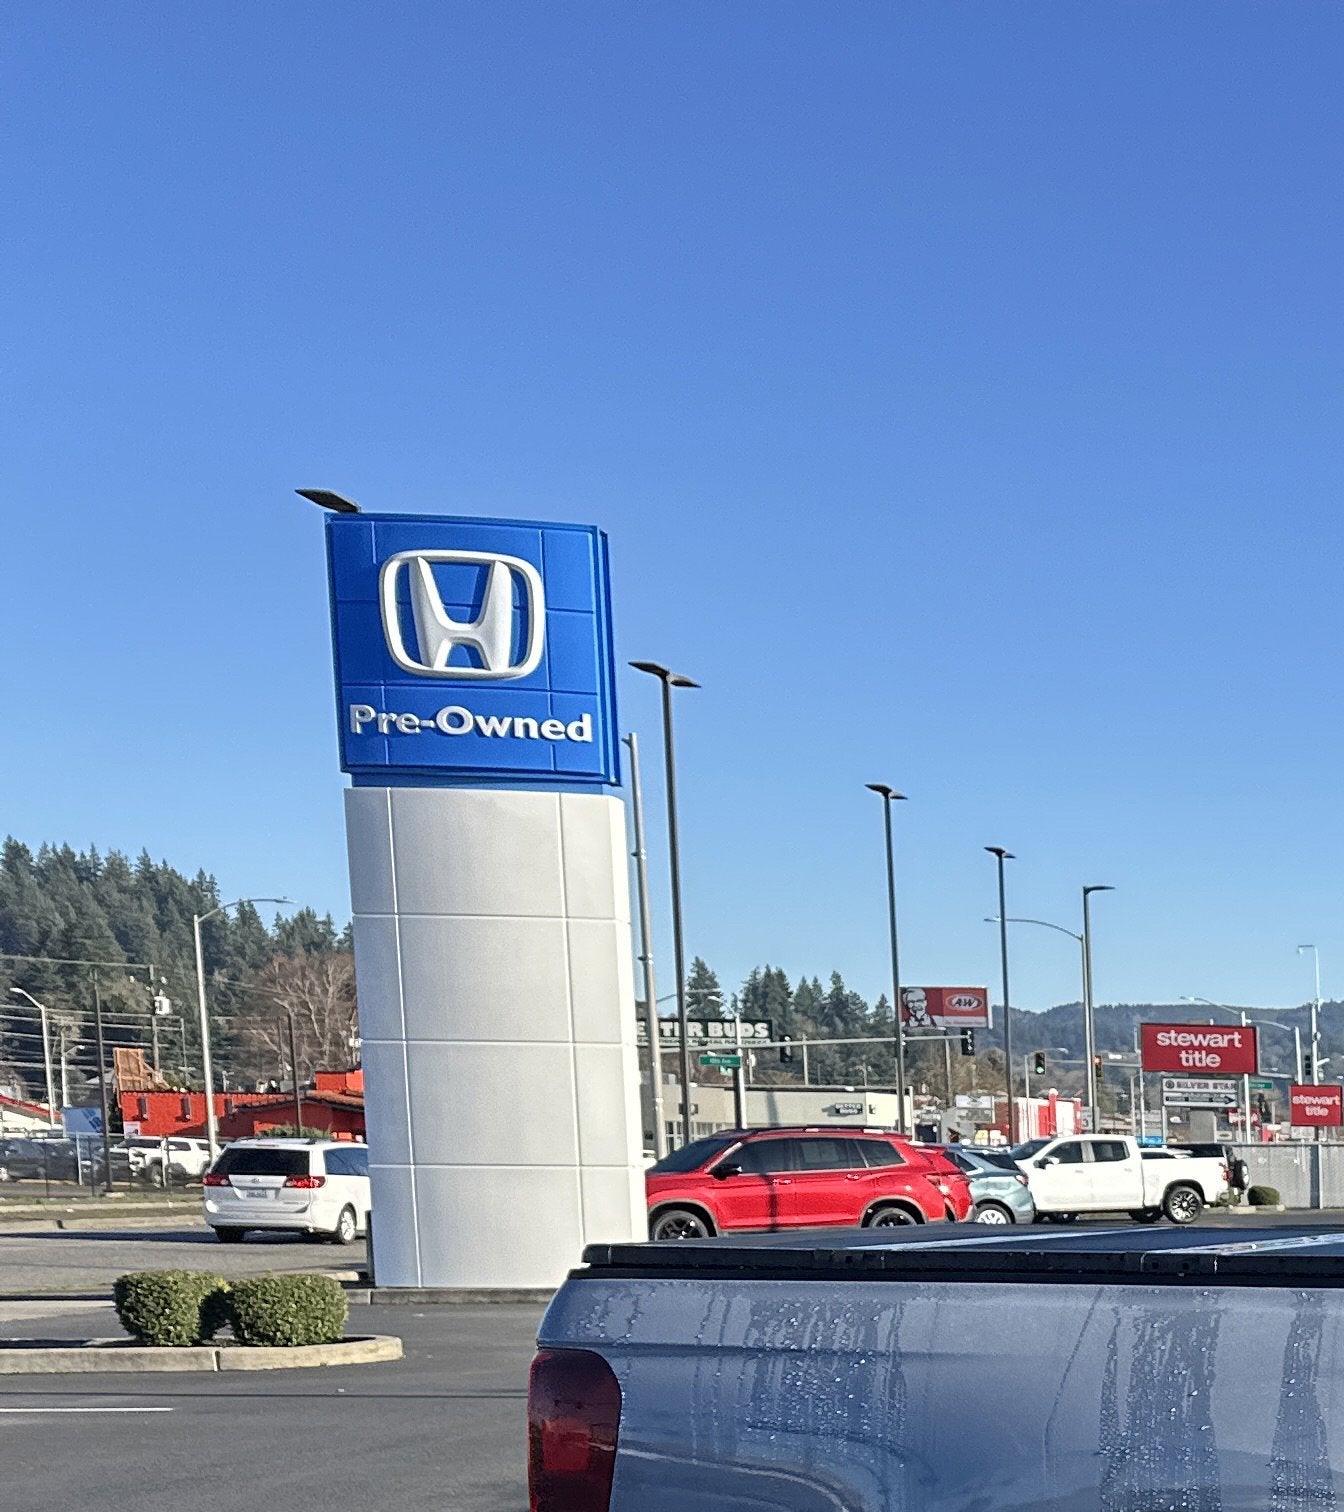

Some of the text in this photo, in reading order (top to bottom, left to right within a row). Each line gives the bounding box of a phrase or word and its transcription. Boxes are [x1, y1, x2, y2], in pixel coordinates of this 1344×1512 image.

[350, 704, 593, 743] Pre-Owned
[637, 1021, 769, 1038] ETR BUDS
[1156, 1029, 1243, 1048] stewart
[1179, 1049, 1222, 1068] title
[1292, 1095, 1340, 1106] stewart
[1304, 1105, 1329, 1117] title
